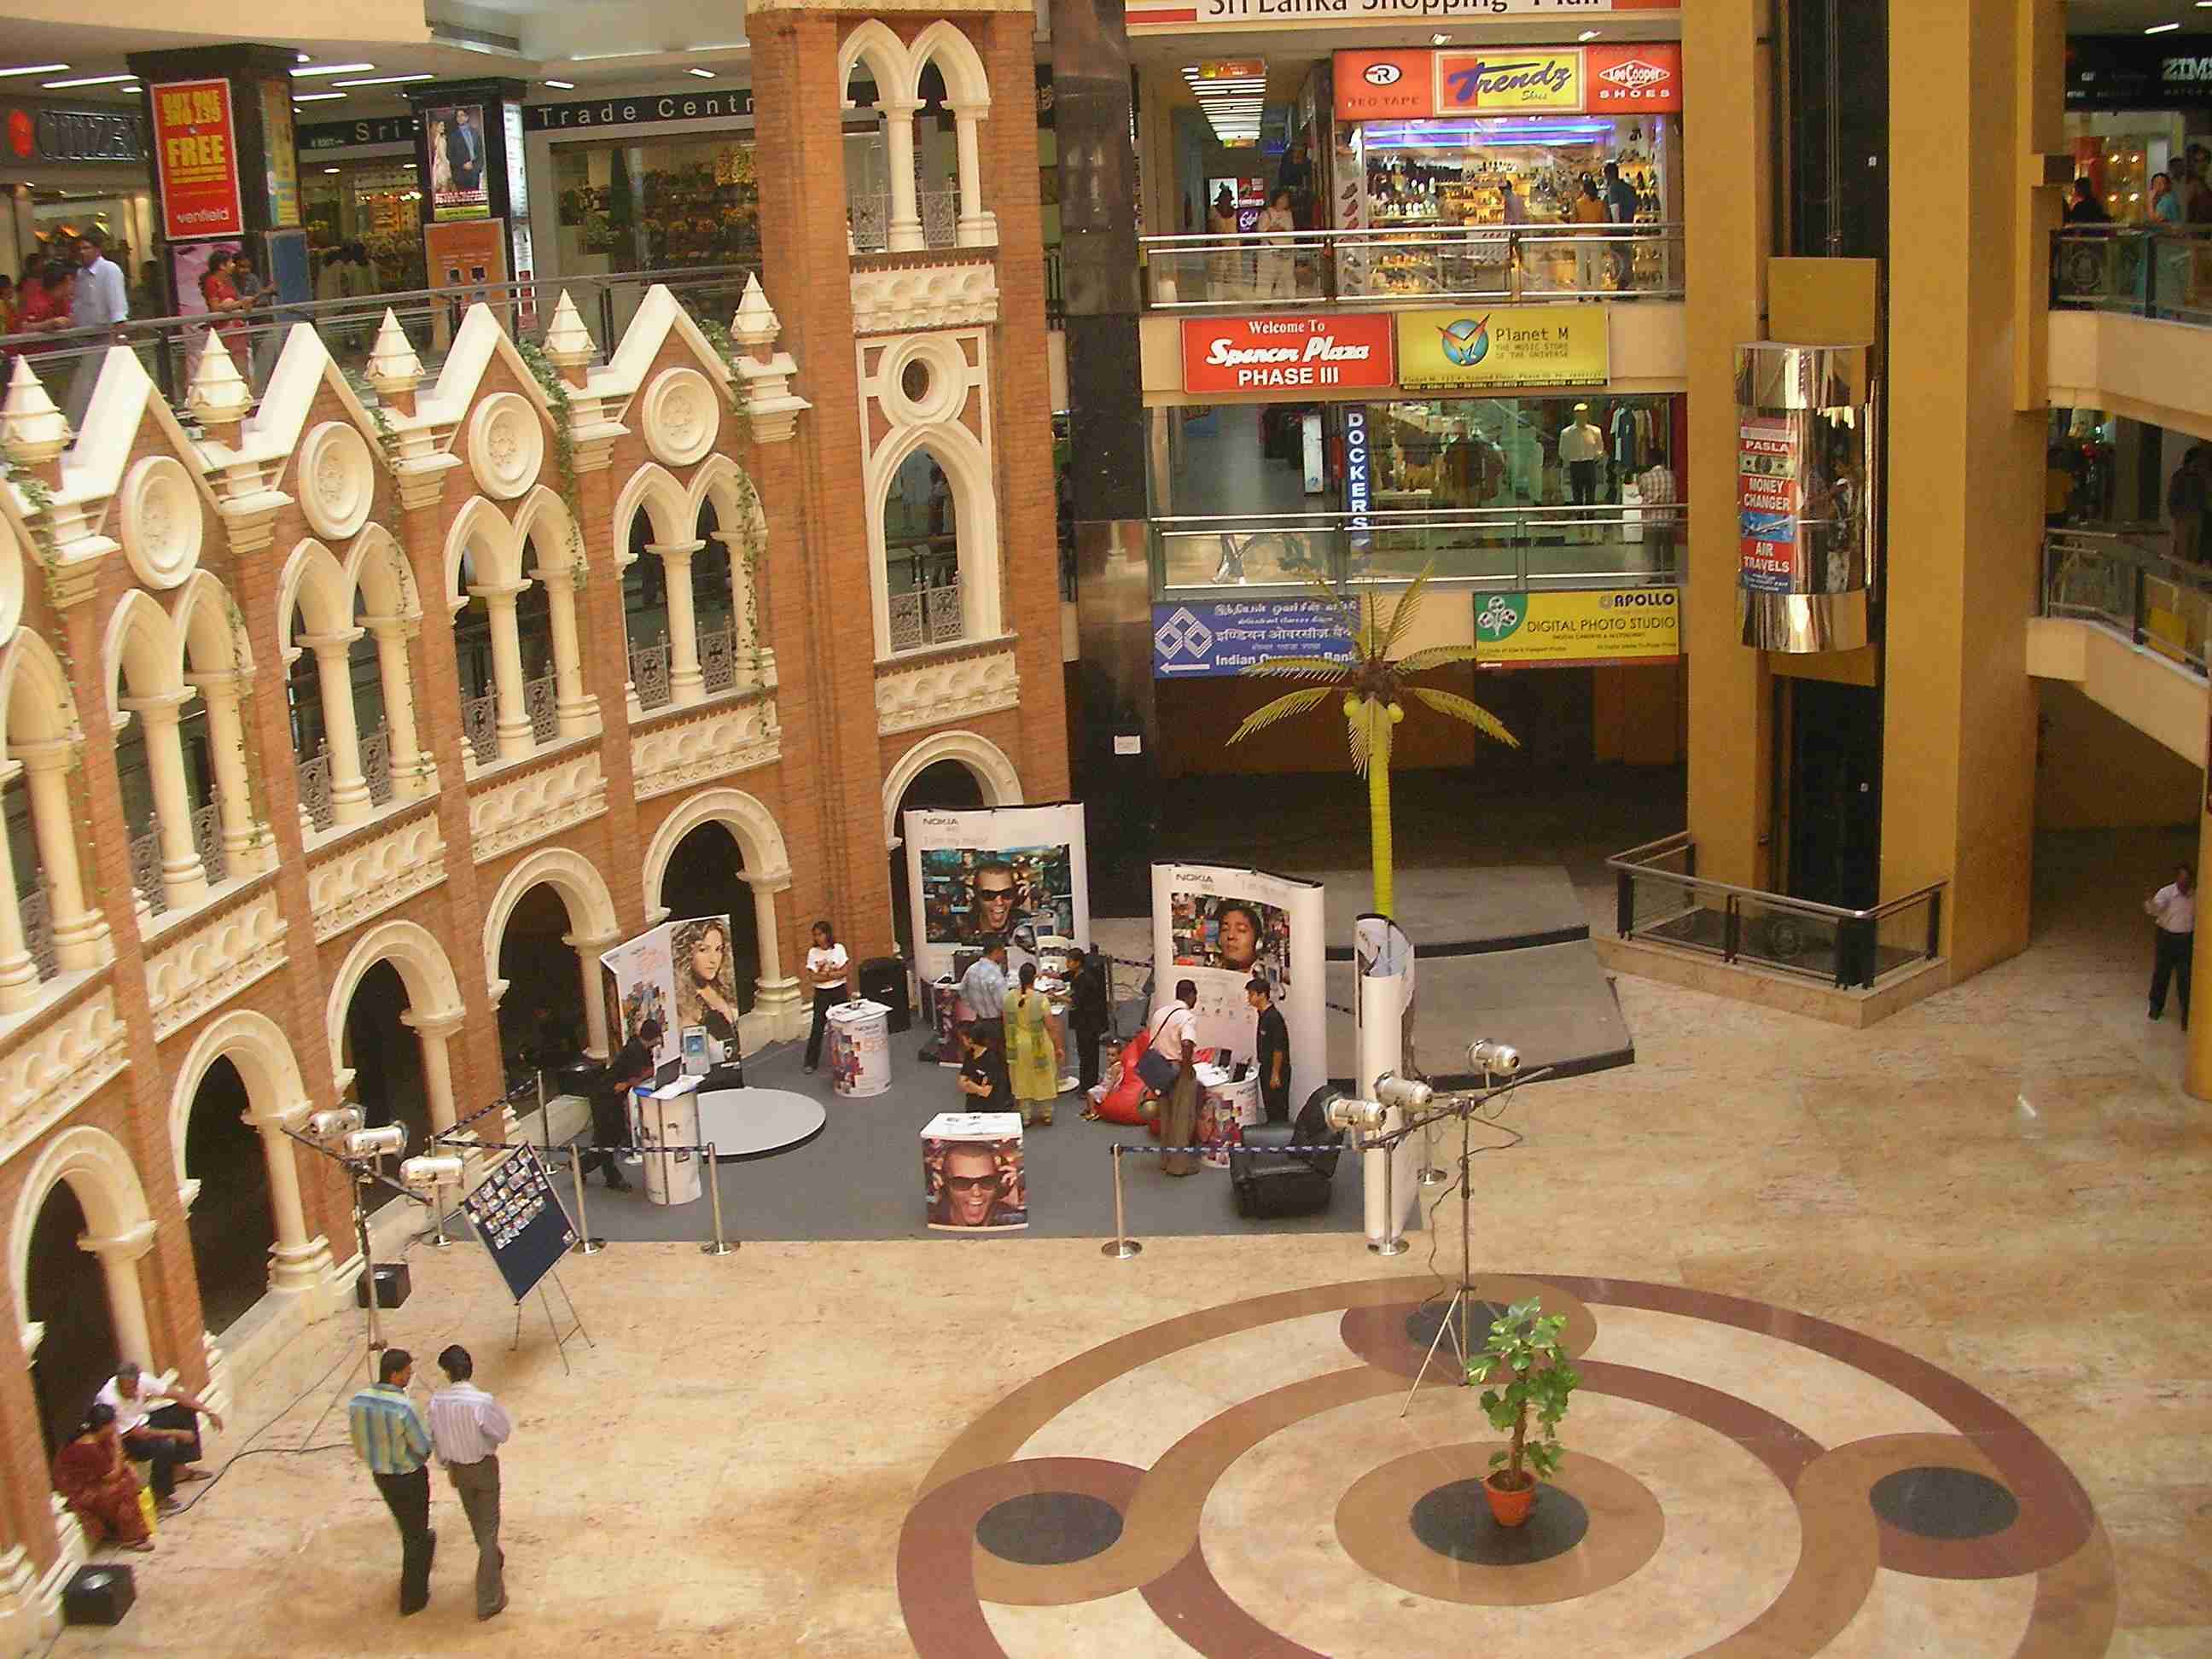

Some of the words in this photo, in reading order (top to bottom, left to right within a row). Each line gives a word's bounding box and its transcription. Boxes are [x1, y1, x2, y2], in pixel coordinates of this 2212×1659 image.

[1208, 0, 1248, 15] Sri
[1259, 0, 1348, 14] Lanka
[1598, 89, 1670, 99] SHOES
[537, 103, 637, 127] Trade
[657, 94, 754, 119] Centr
[355, 121, 400, 142] Sri
[166, 135, 226, 168] FREE
[1249, 320, 1305, 335] Welcome
[1308, 319, 1325, 333] To
[1495, 327, 1550, 341] Planet
[1557, 326, 1569, 341] M
[1206, 338, 1299, 367] Spencer
[1301, 335, 1370, 363] Plaza
[1237, 367, 1314, 387] PHASE
[1320, 366, 1339, 384] III
[1348, 412, 1368, 528] DOCKERS
[1749, 478, 1784, 493] MONEY
[1743, 493, 1790, 511] CHANGER
[1755, 542, 1773, 557] AIR
[1743, 556, 1790, 573] TRAVELS
[1614, 593, 1675, 608] APOLLO
[1527, 620, 1578, 633] DIGITAL
[1580, 619, 1627, 632] PHOTO
[1629, 616, 1676, 629] STUDIO
[1215, 653, 1257, 667] Indian
[922, 818, 958, 826] NOKIA
[1175, 873, 1214, 883] NOKIA
